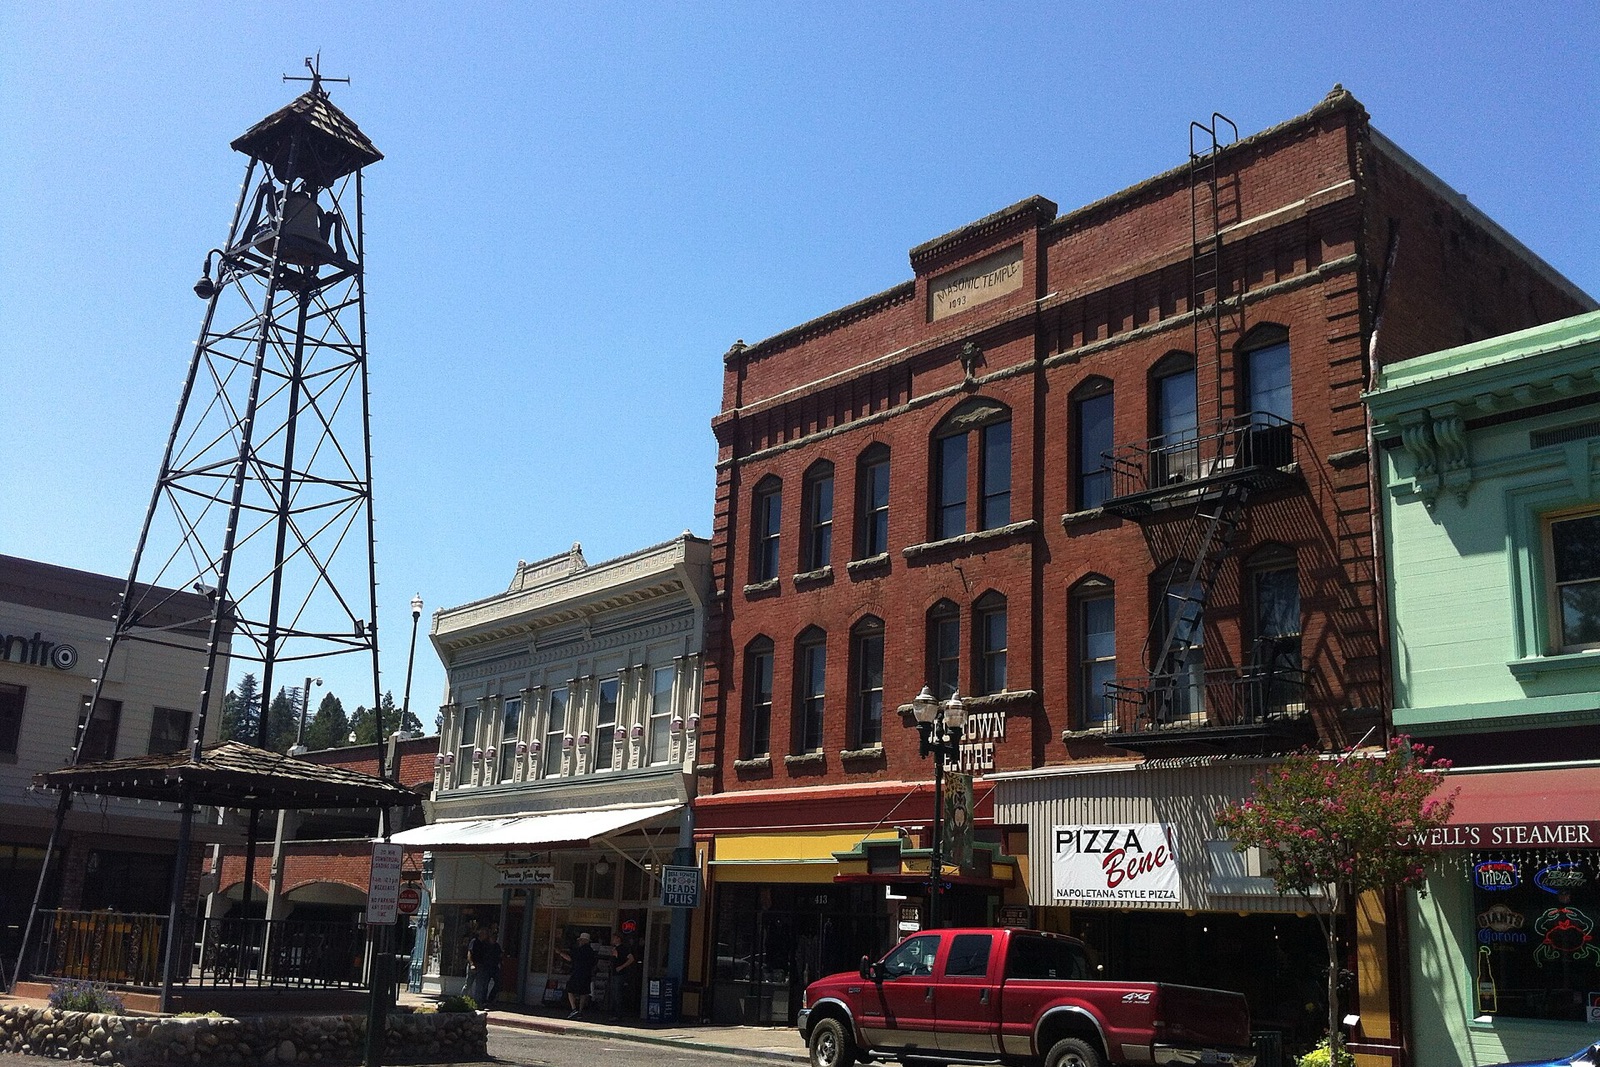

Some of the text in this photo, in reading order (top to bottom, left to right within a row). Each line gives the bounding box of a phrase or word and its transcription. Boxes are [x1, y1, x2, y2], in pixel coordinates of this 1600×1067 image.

[937, 276, 980, 303] MASONIC
[942, 742, 994, 772] ENTRE
[1056, 829, 1144, 853] PIZZA
[1384, 824, 1594, 847] OWELL'S STEAMER
[1102, 827, 1174, 888] Bene!
[666, 883, 696, 894] BEADS
[1056, 888, 1176, 899] NAPOLETANA STYLE PIZZA
[668, 894, 694, 905] PLUS
[815, 895, 828, 904] 413
[1479, 910, 1522, 929] GIANTS
[1477, 928, 1527, 945] Corona
